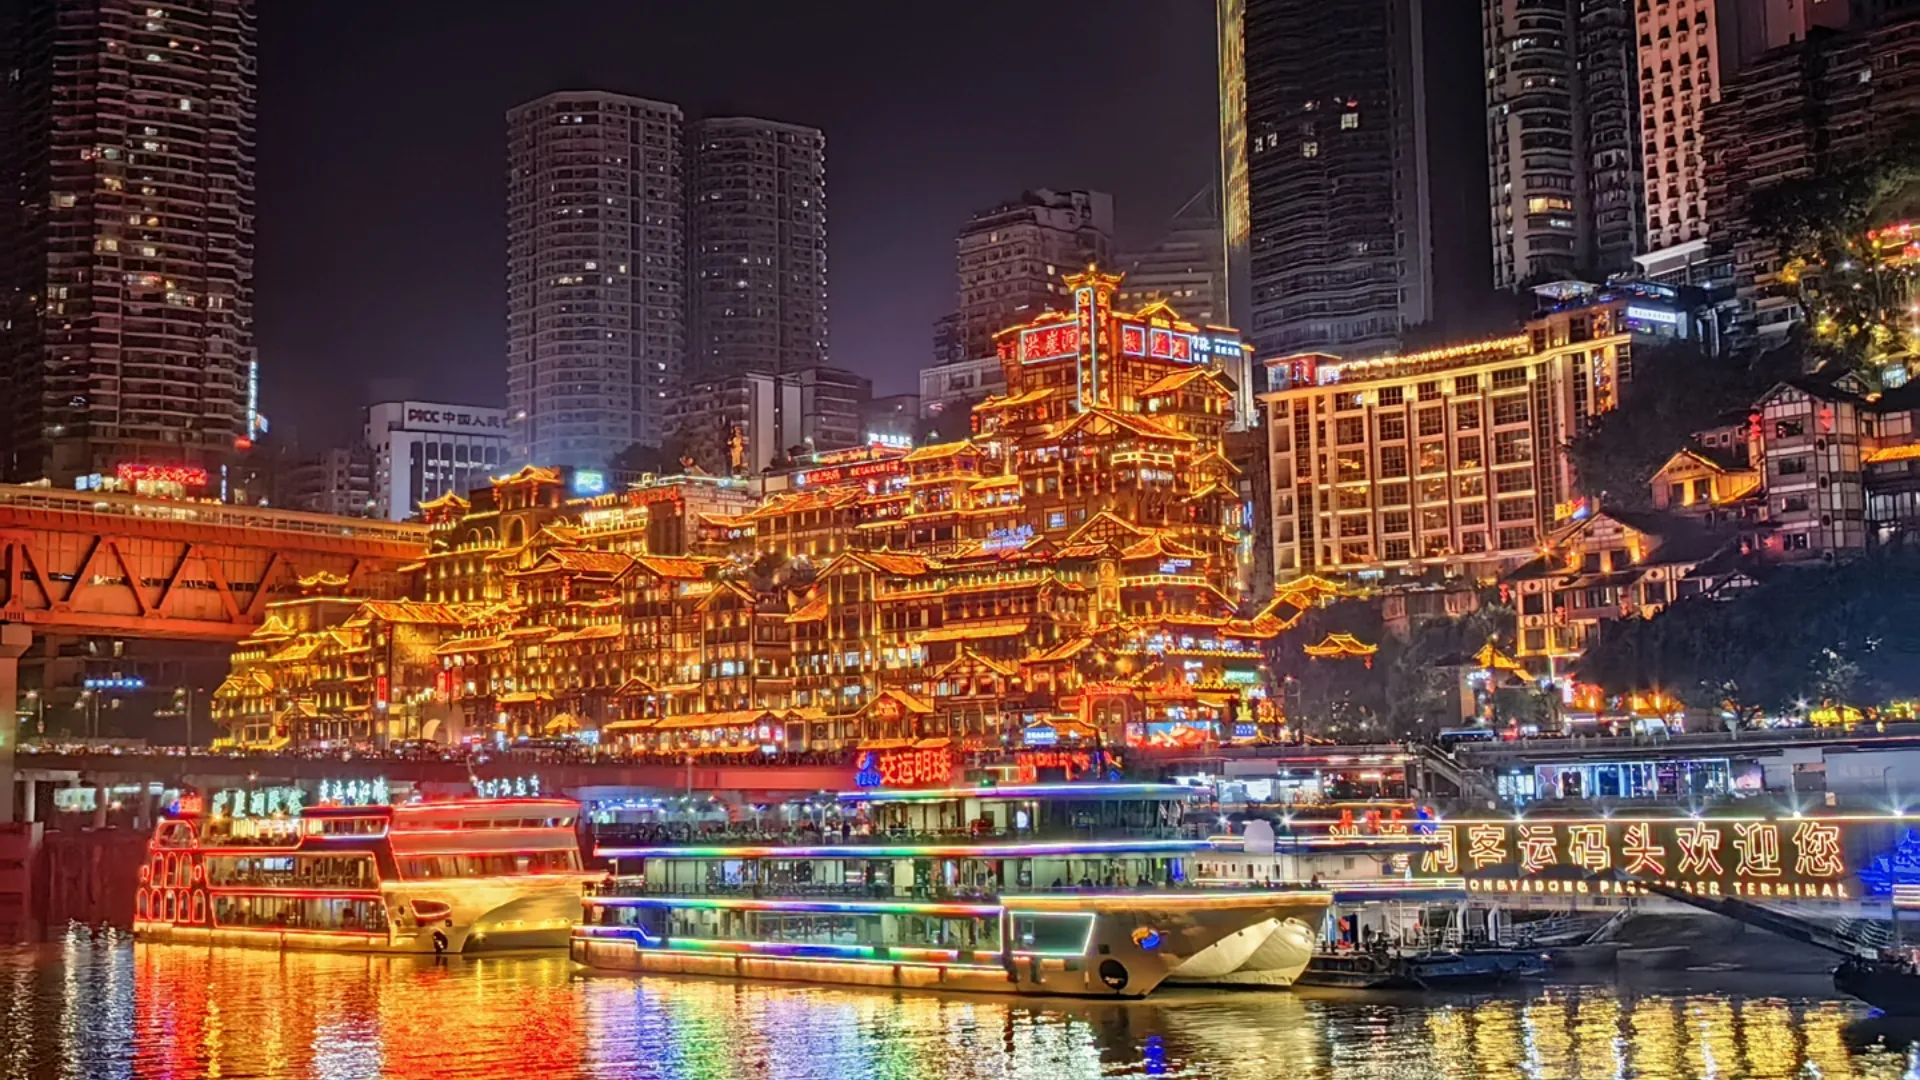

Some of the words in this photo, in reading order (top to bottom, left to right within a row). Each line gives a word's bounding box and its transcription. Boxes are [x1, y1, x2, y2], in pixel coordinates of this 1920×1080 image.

[1024, 327, 1079, 359] 洪崖洞
[880, 748, 952, 785] 交运明珠
[1469, 879, 1588, 893] ONGYADONG
[1733, 882, 1848, 898] TERMINAL
